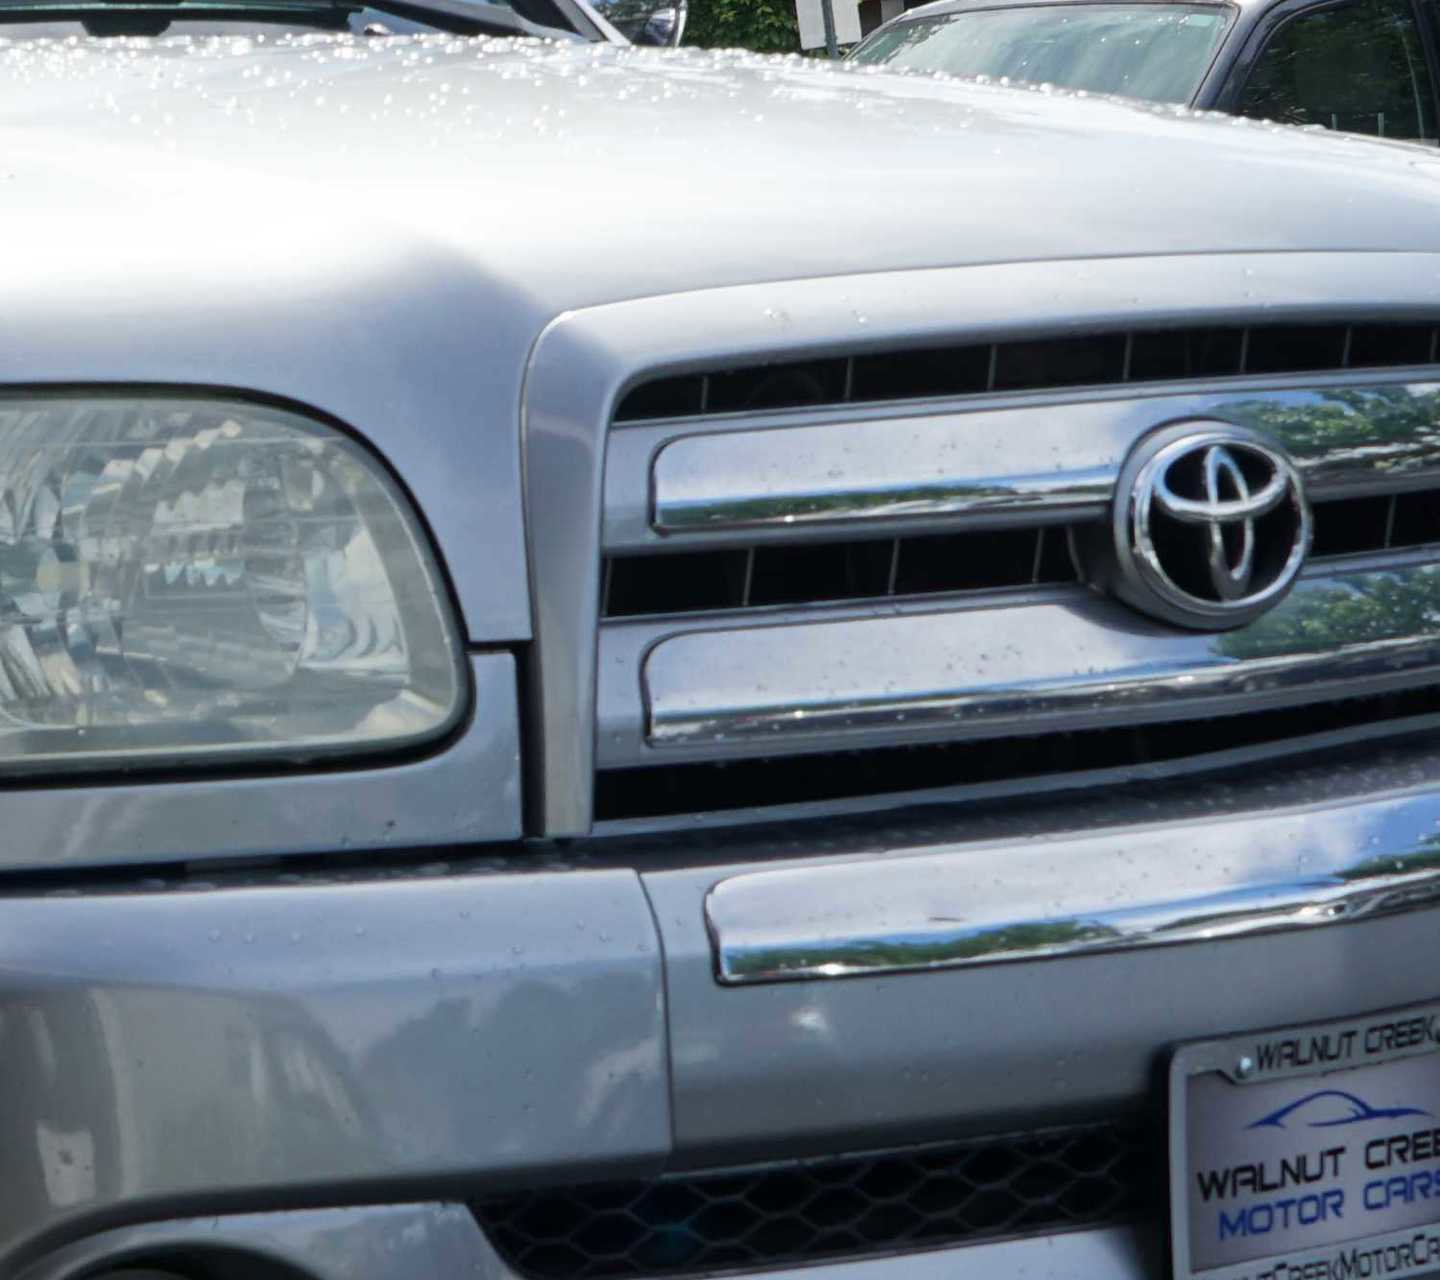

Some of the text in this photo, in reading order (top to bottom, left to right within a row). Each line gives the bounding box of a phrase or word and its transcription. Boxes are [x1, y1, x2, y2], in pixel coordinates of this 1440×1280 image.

[1256, 1016, 1437, 1070] WALNUT CREEK
[1196, 1146, 1346, 1203] WALNUT
[1219, 1188, 1345, 1241] MOTOR
